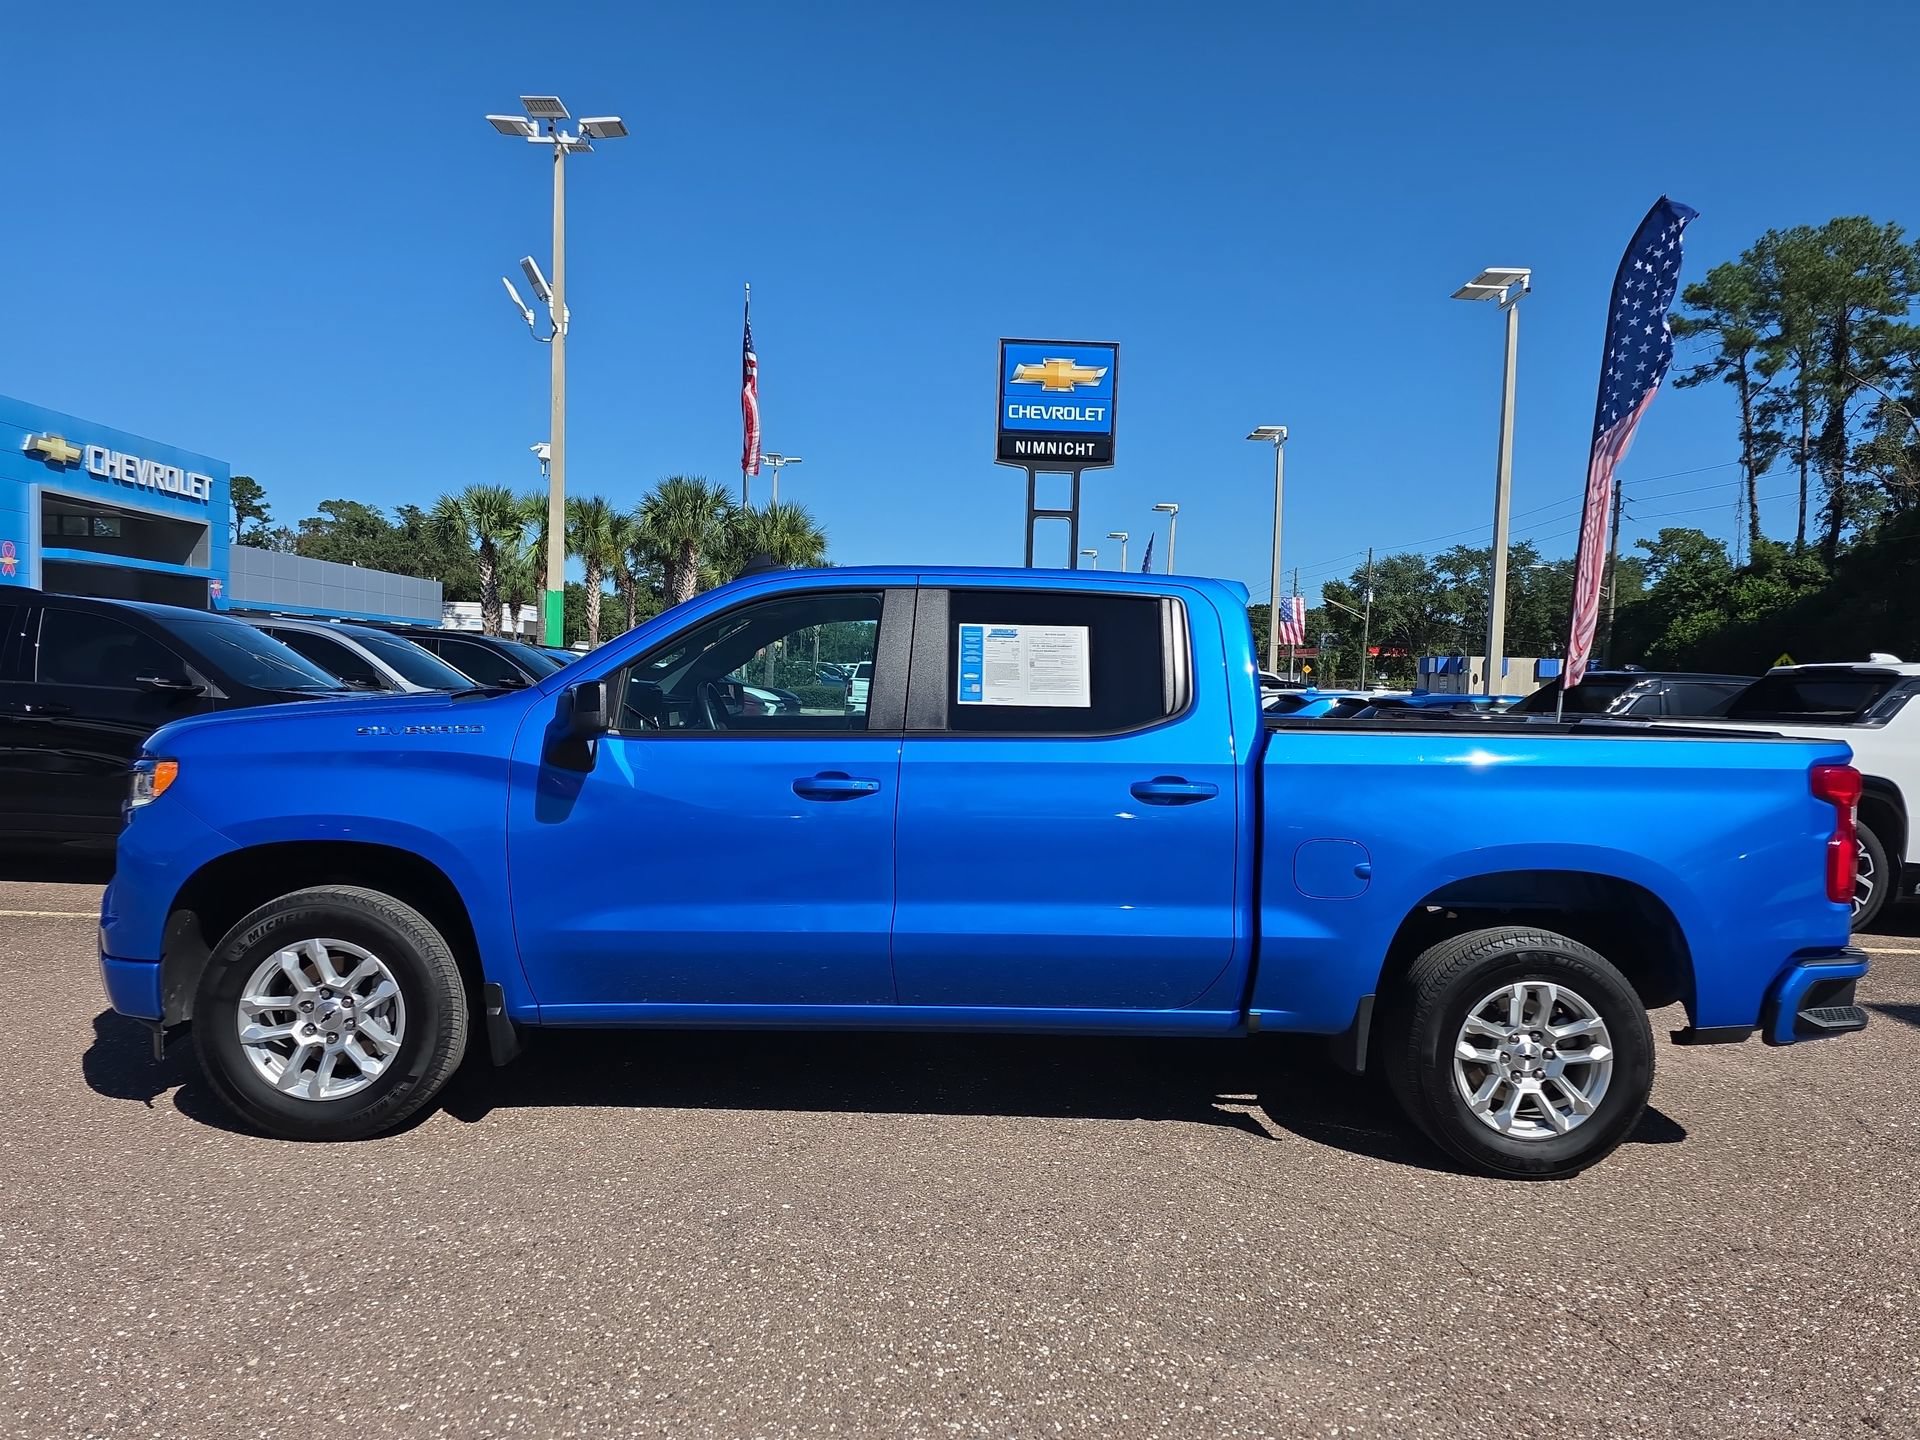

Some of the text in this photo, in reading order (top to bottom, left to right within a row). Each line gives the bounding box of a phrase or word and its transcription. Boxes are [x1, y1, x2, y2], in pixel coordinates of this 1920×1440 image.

[1008, 404, 1106, 422] CHEVROLET
[1015, 440, 1095, 456] NIMNICHT
[85, 444, 213, 501] CHEVROLET
